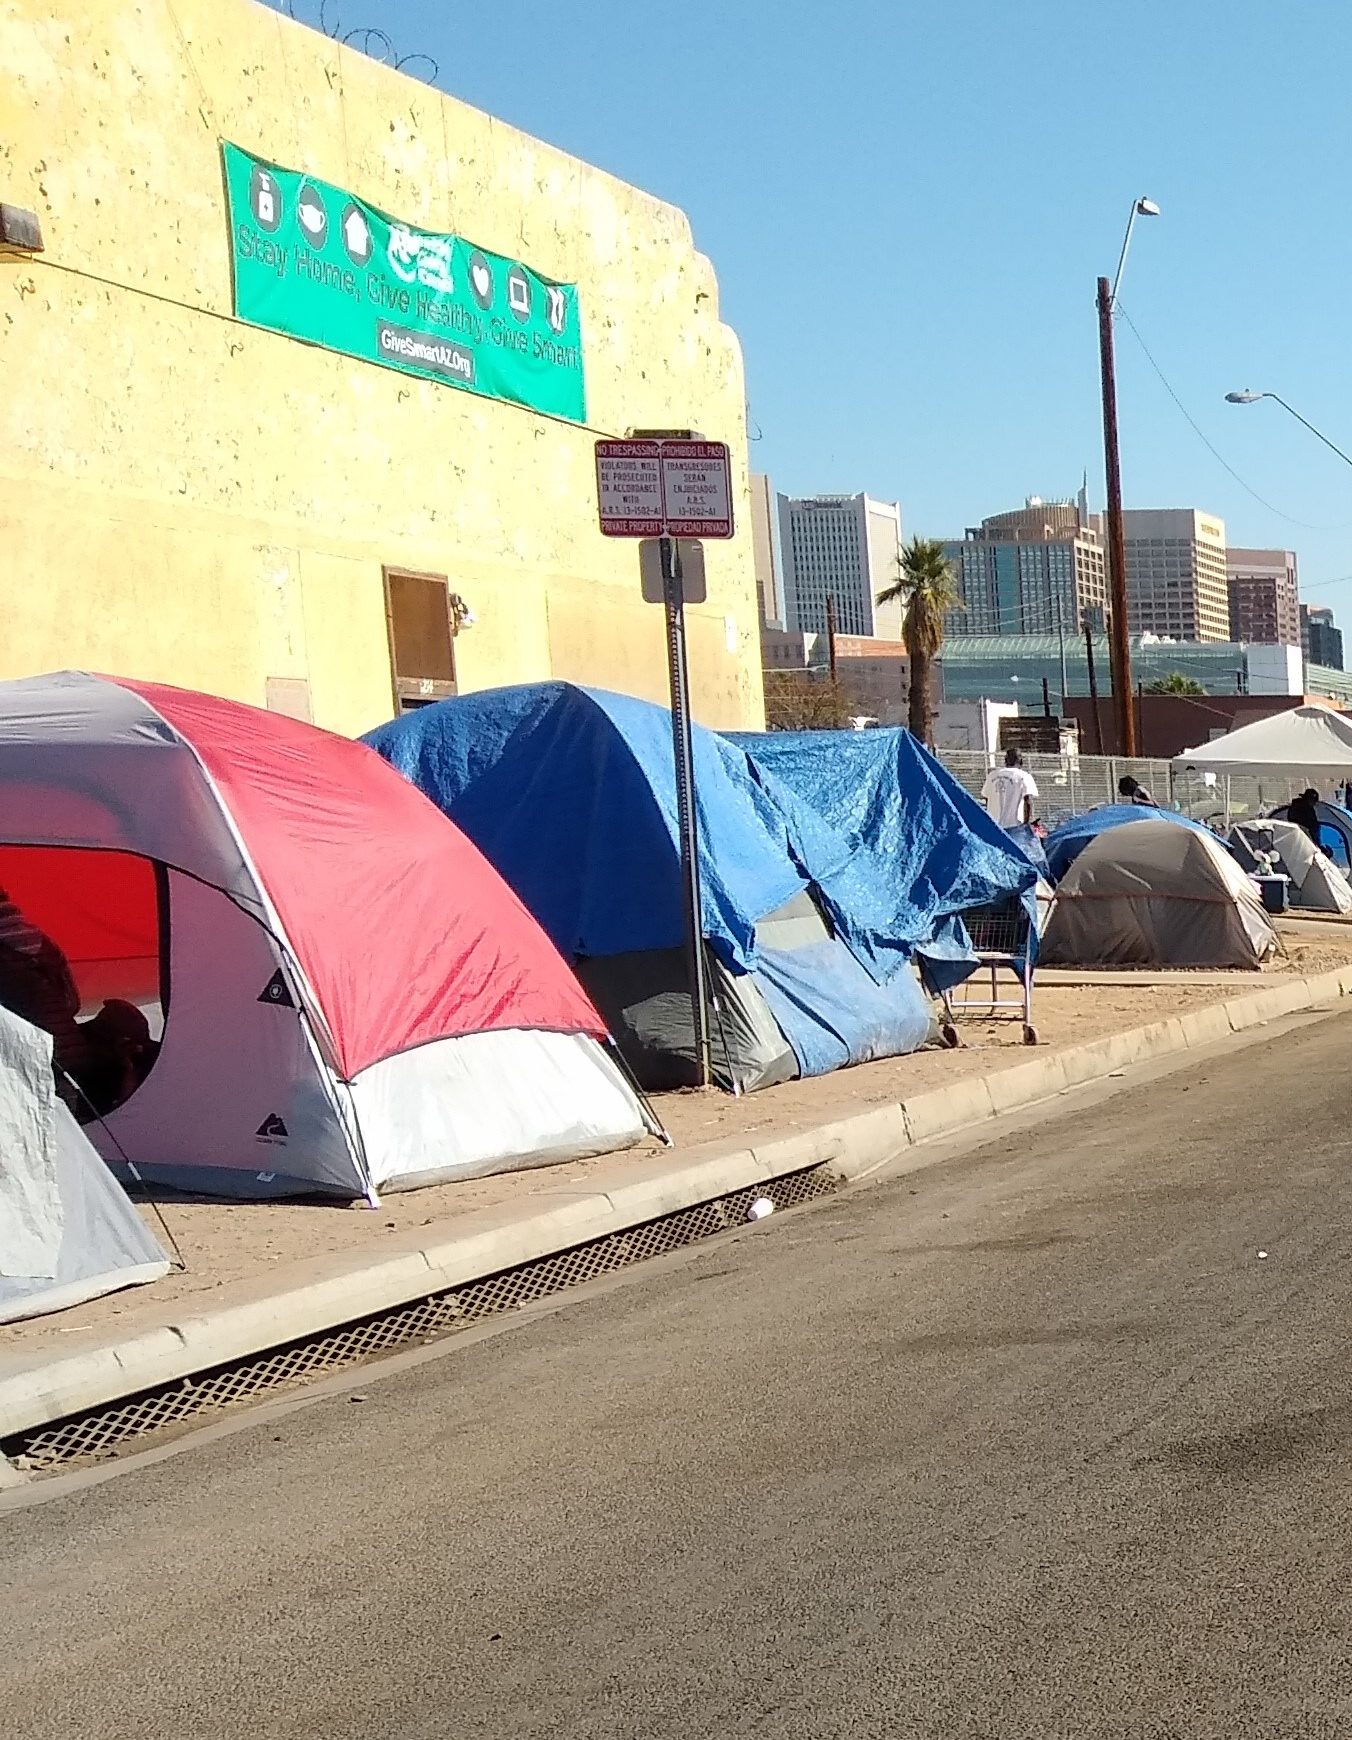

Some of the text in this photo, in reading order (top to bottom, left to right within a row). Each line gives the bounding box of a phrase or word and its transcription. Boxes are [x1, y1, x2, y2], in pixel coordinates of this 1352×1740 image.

[238, 224, 287, 277] Stay
[294, 244, 360, 303] Home,
[366, 271, 410, 313] Give
[488, 316, 528, 353] Give
[597, 445, 659, 457] NO TRESPASSING
[662, 445, 697, 457] PROHIBIDO
[707, 446, 724, 458] PASO
[602, 521, 628, 531] PRIVATE
